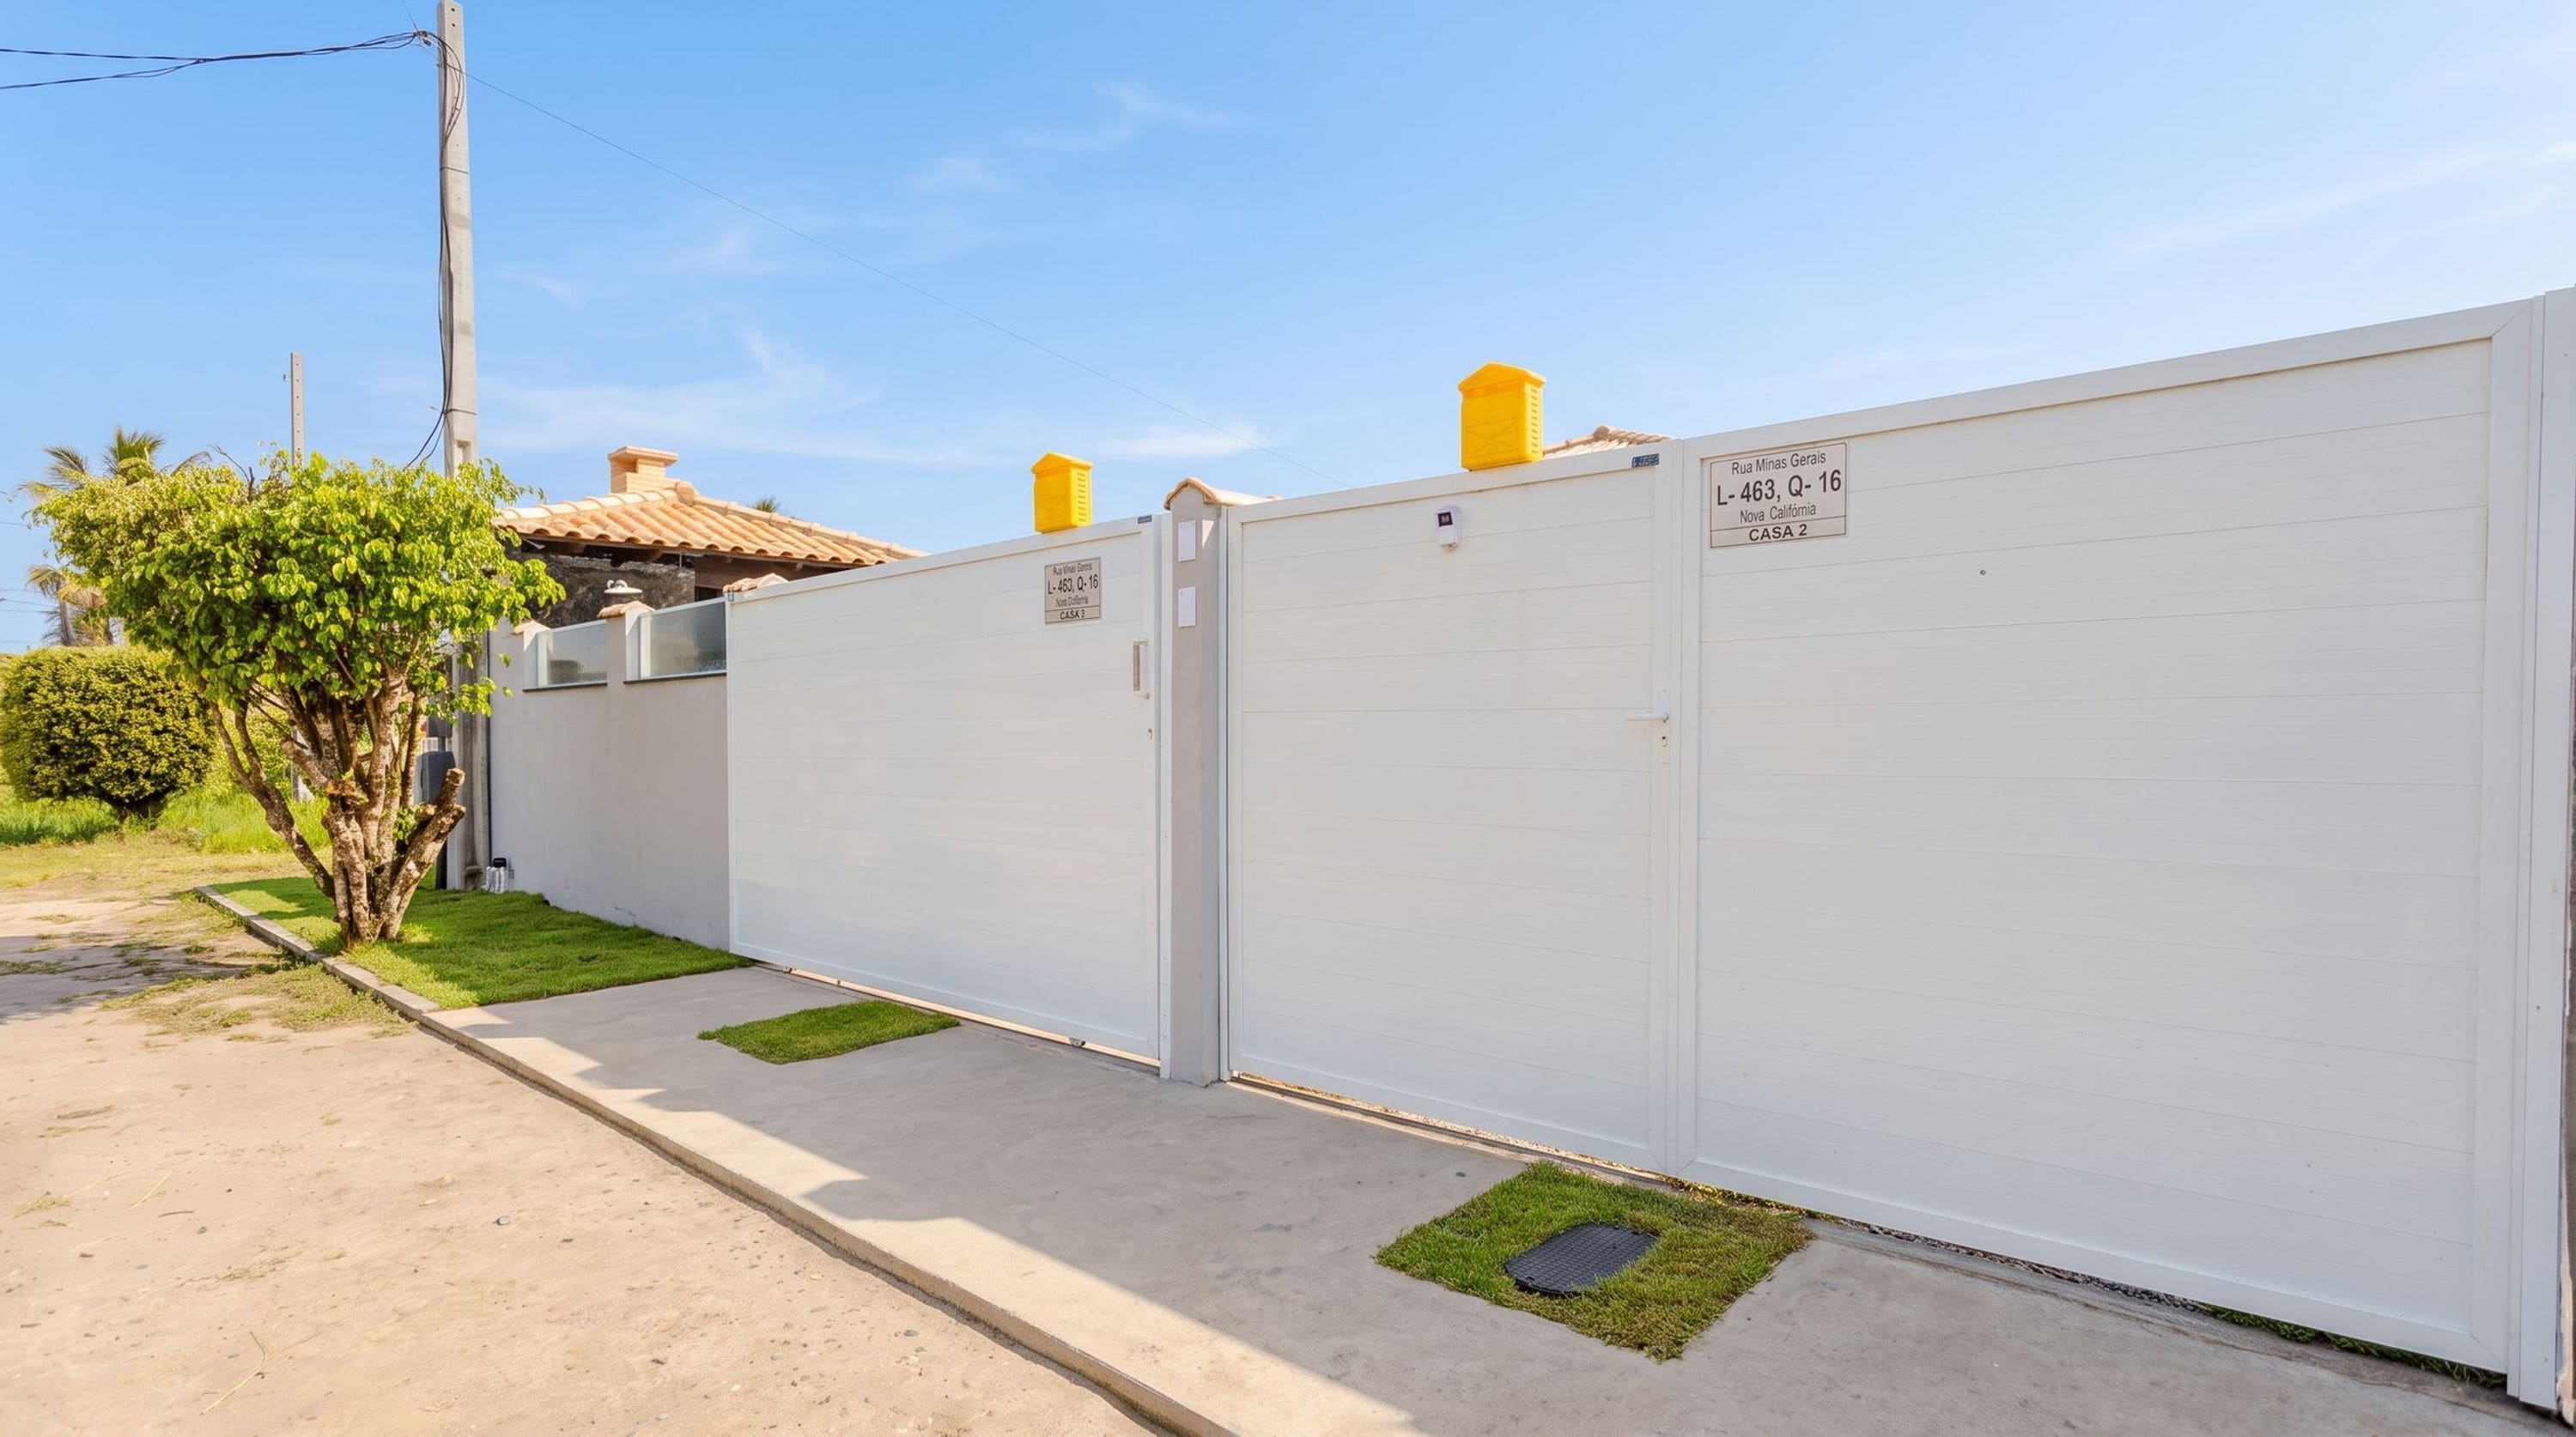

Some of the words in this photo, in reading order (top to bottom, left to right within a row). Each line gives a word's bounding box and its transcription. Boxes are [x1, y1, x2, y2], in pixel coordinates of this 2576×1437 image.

[1732, 461, 1753, 476] Rua
[1756, 458, 1787, 472] Minas
[1790, 451, 1826, 467] Gerais
[1717, 486, 1735, 506] L-
[1741, 479, 1781, 503] 463,
[1789, 475, 1812, 497] Q-
[1819, 470, 1842, 493] 16
[1741, 510, 1765, 524] Nova
[1749, 525, 1794, 542] CASA
[1799, 524, 1807, 536] 2
[1089, 573, 1098, 589] 16
[1060, 610, 1080, 620] CASA
